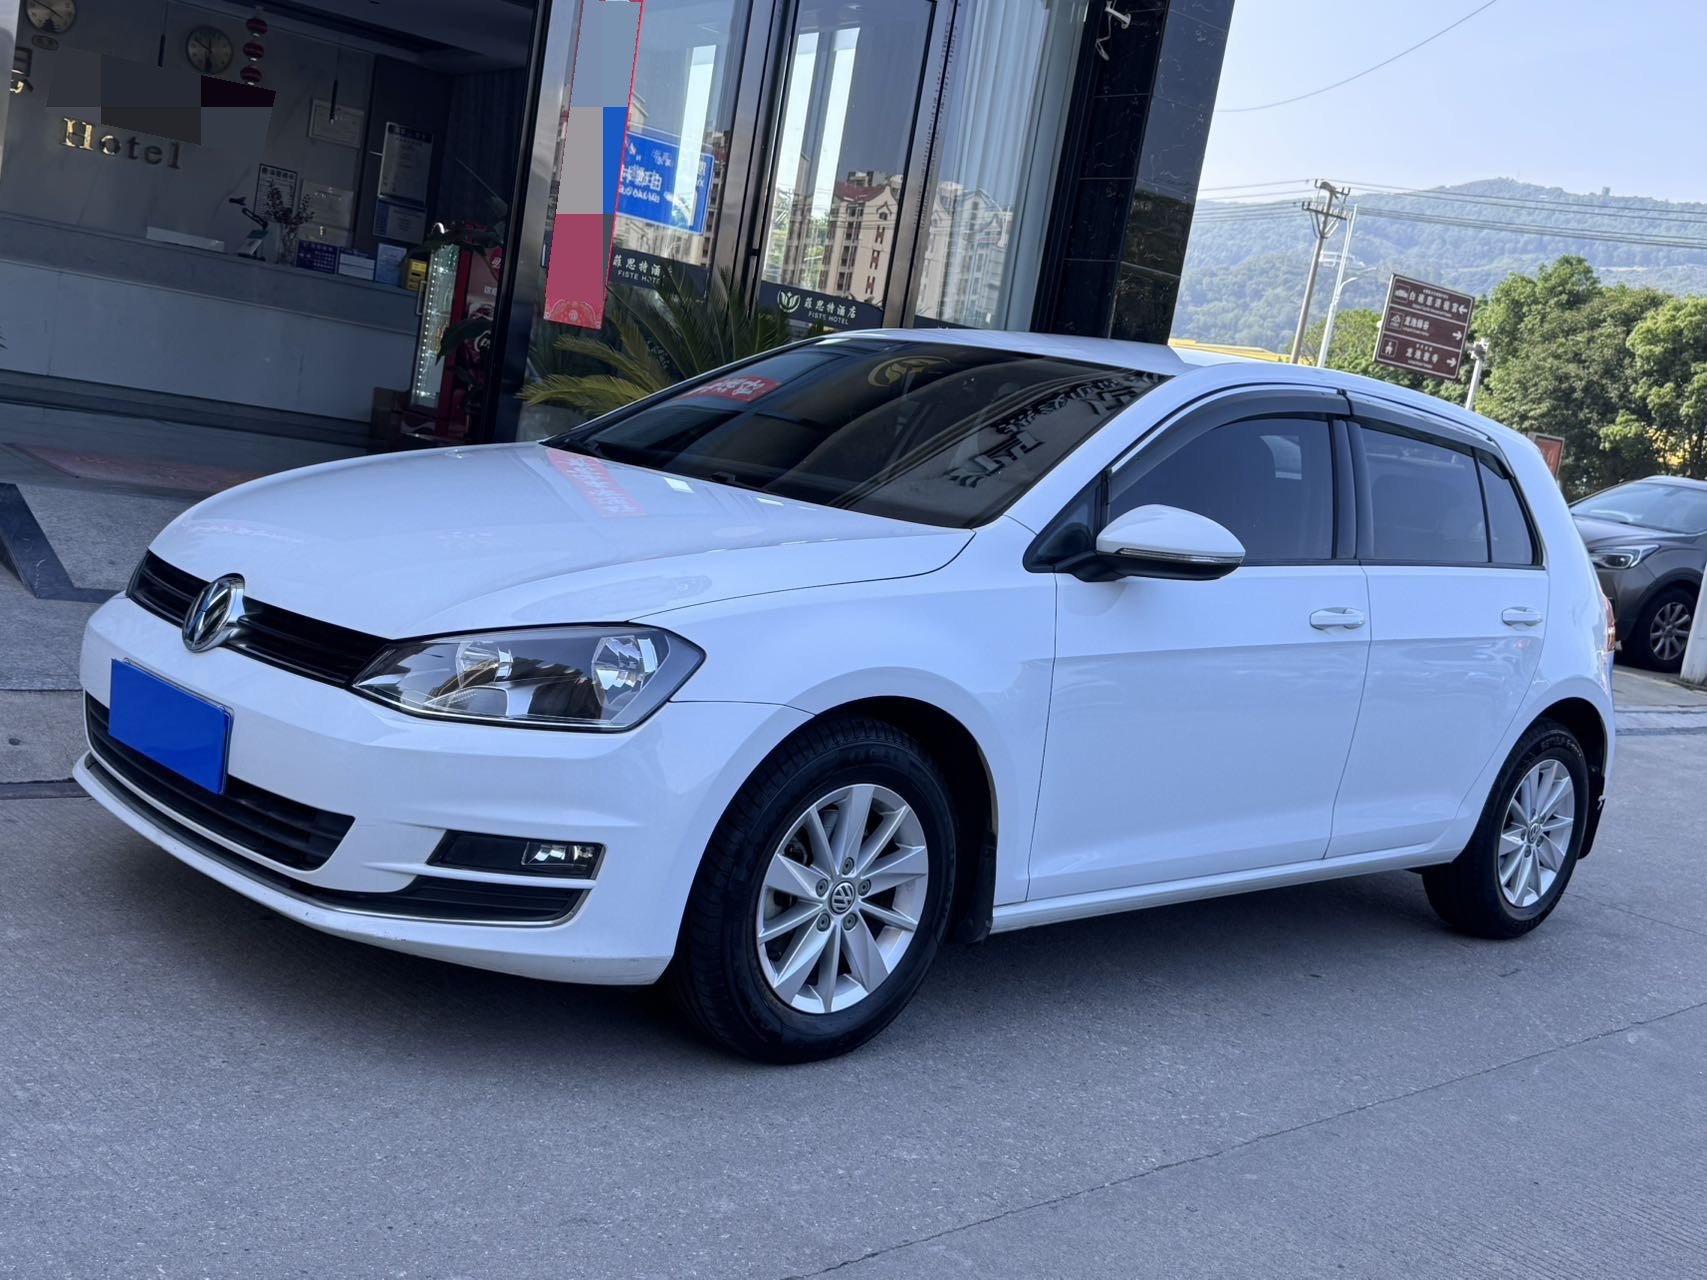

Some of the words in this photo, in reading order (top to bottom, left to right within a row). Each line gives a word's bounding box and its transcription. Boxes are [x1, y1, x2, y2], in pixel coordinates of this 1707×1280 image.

[60, 117, 181, 169] Hotel
[613, 254, 673, 277] 菲思特酒
